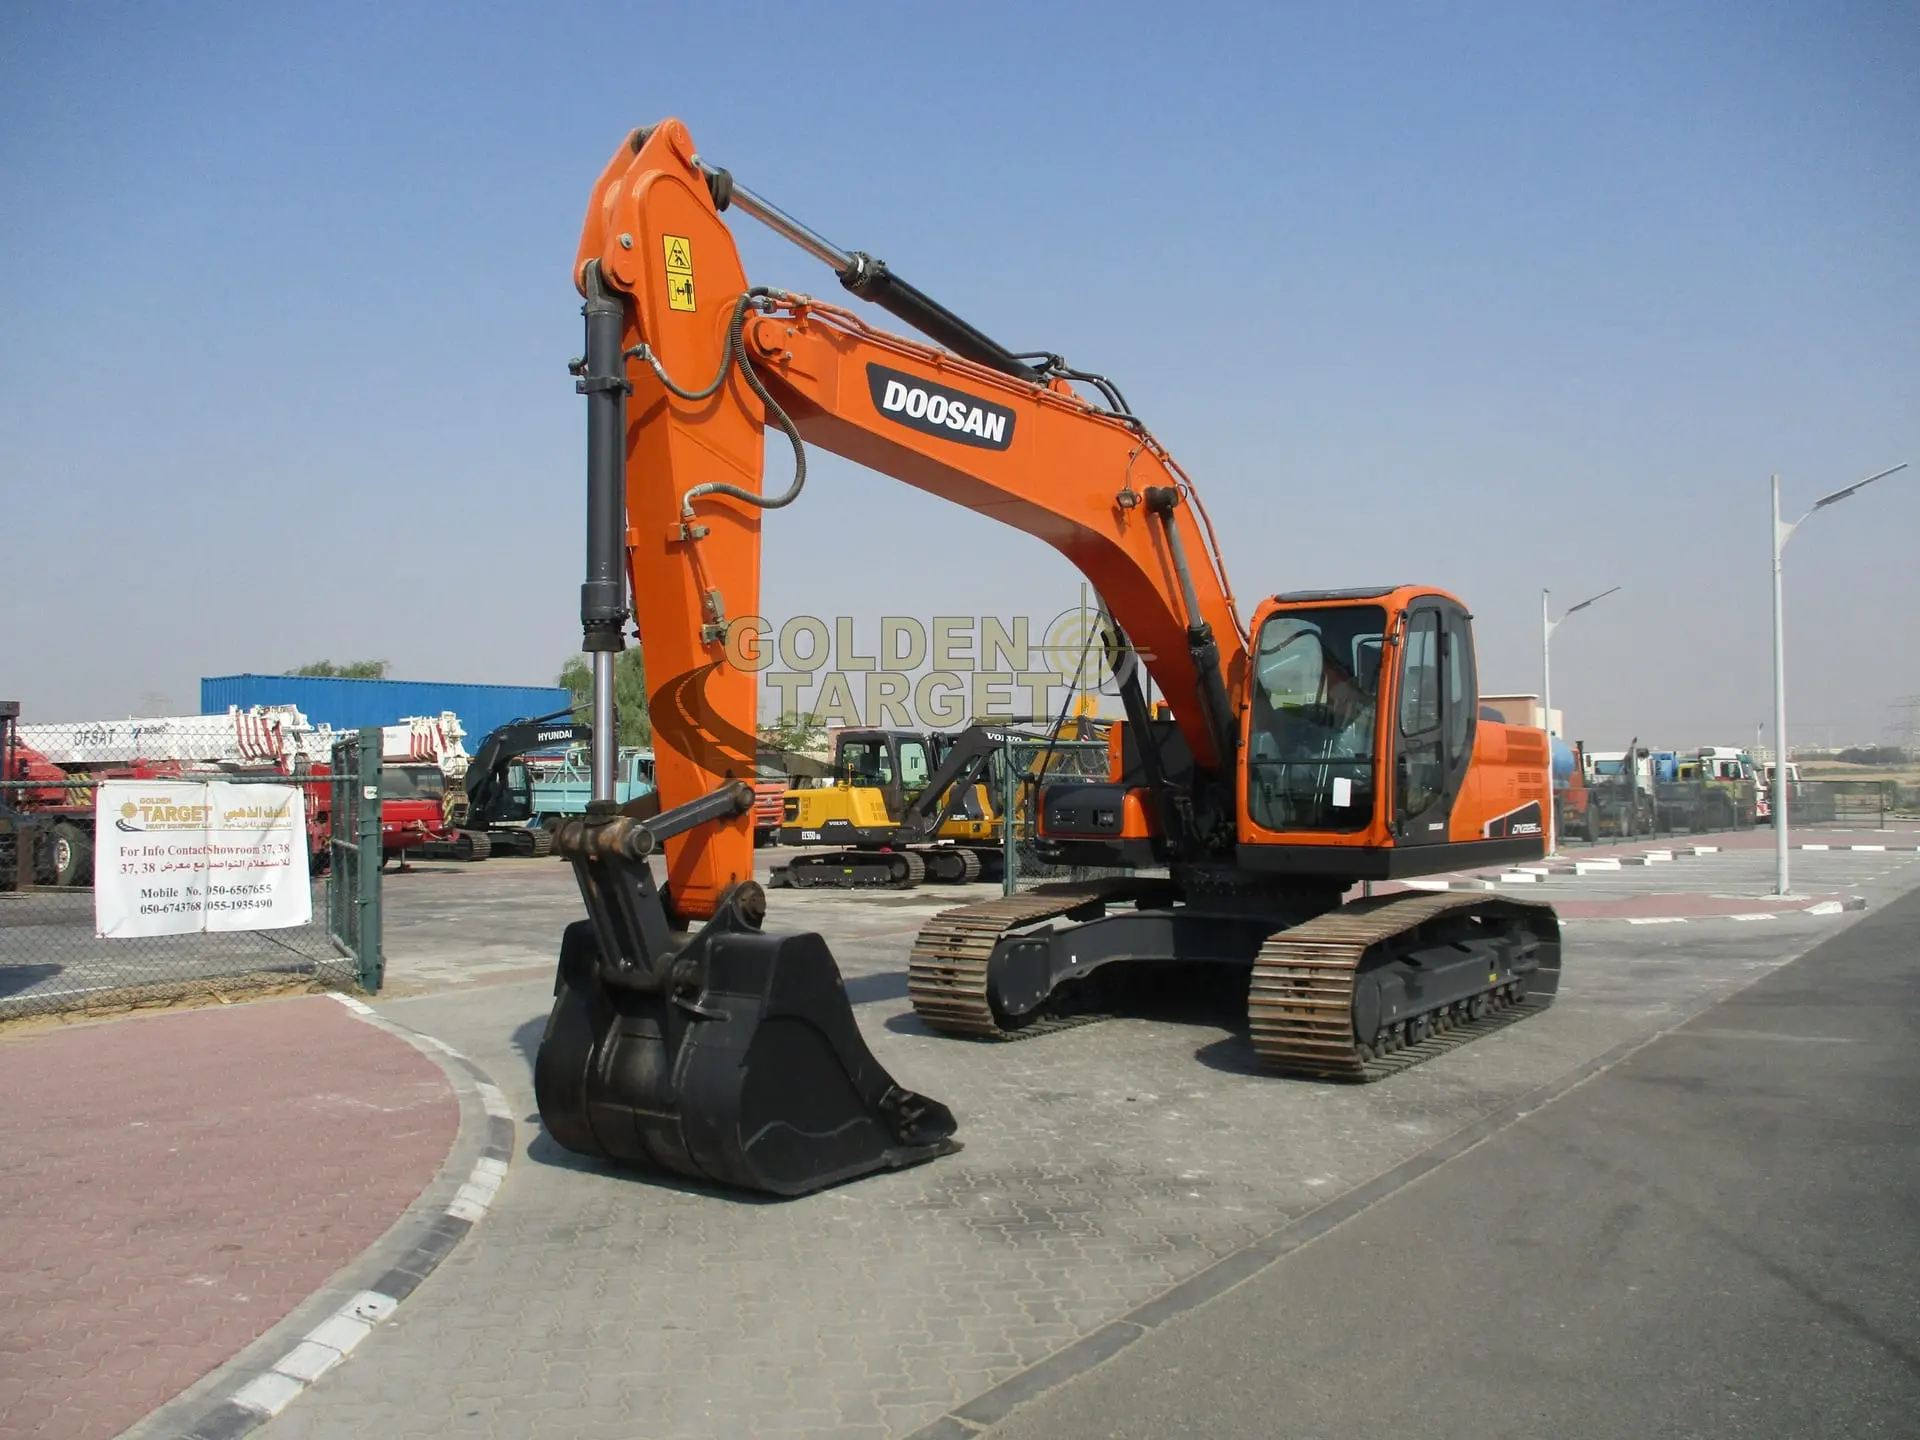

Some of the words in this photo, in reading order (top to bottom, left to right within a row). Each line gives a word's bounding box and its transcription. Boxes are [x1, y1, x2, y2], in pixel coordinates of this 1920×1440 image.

[882, 380, 1006, 443] DOOSAN
[538, 730, 573, 742] HYUNDAI
[139, 796, 172, 804] GOLDEN
[139, 806, 213, 822] TARGET
[223, 805, 262, 822] الذهبي
[120, 846, 140, 857] For
[143, 845, 165, 857] Info
[262, 843, 276, 855] 37,
[277, 843, 290, 853] 38
[120, 863, 138, 875] 37,
[141, 863, 156, 873] 38
[160, 861, 190, 873] معرض
[193, 862, 205, 873] مع
[140, 888, 179, 898] Mobile
[186, 886, 202, 897] No.
[207, 883, 272, 896] 050-6567655
[140, 901, 202, 915] 050-6743768
